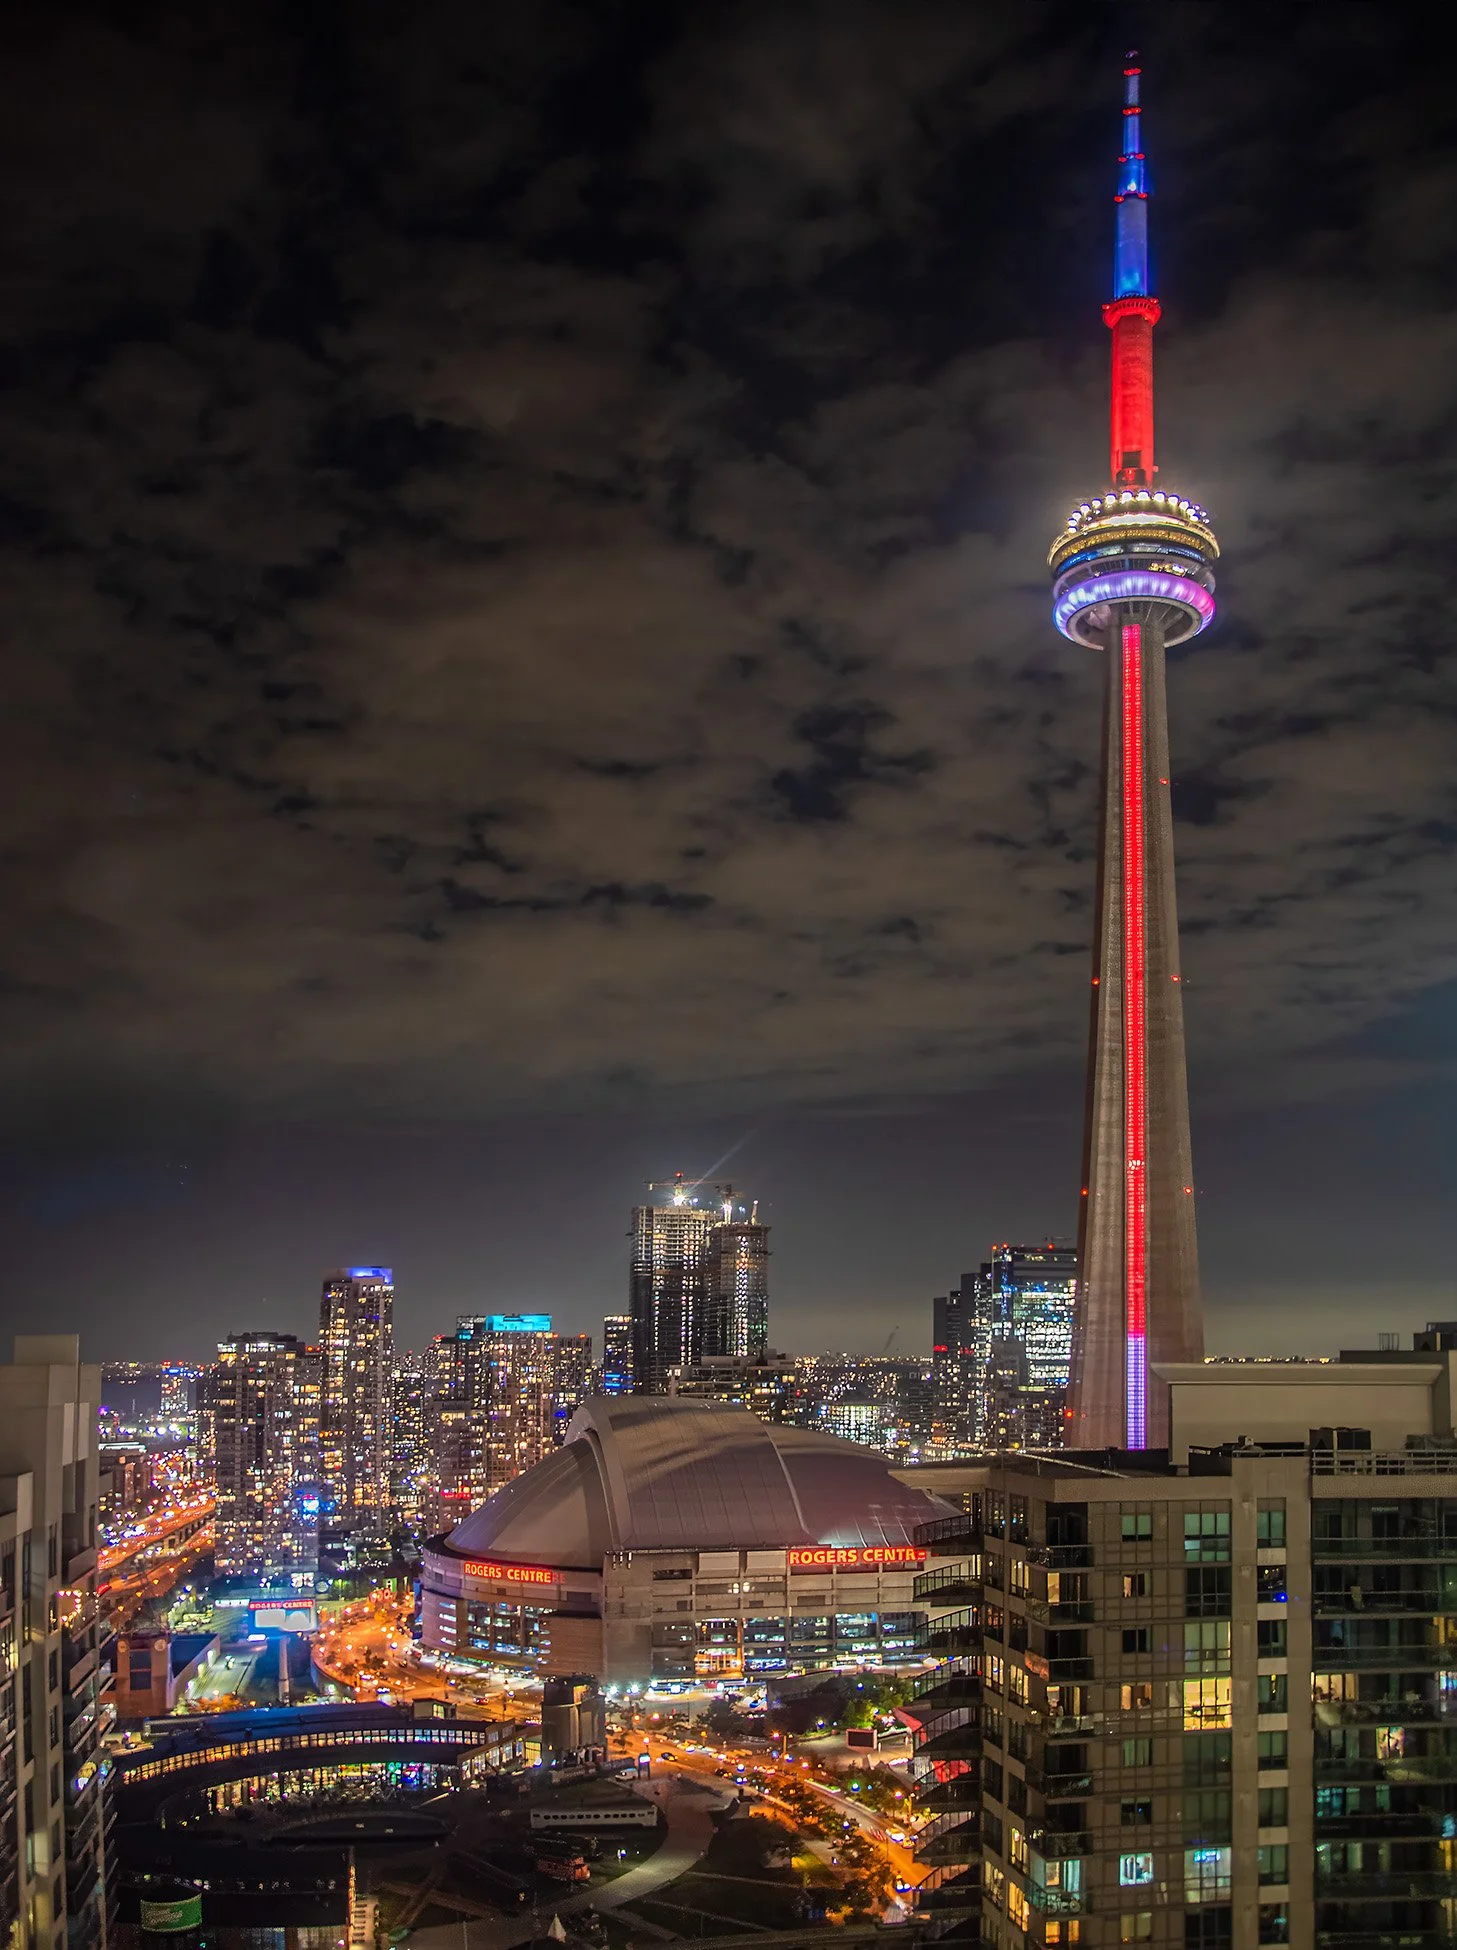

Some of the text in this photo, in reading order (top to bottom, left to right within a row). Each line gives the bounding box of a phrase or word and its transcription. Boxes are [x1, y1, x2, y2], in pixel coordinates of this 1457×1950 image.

[789, 1549, 857, 1564] ROGERS
[465, 1563, 502, 1578] ROGERS
[507, 1568, 552, 1583] CENTRE
